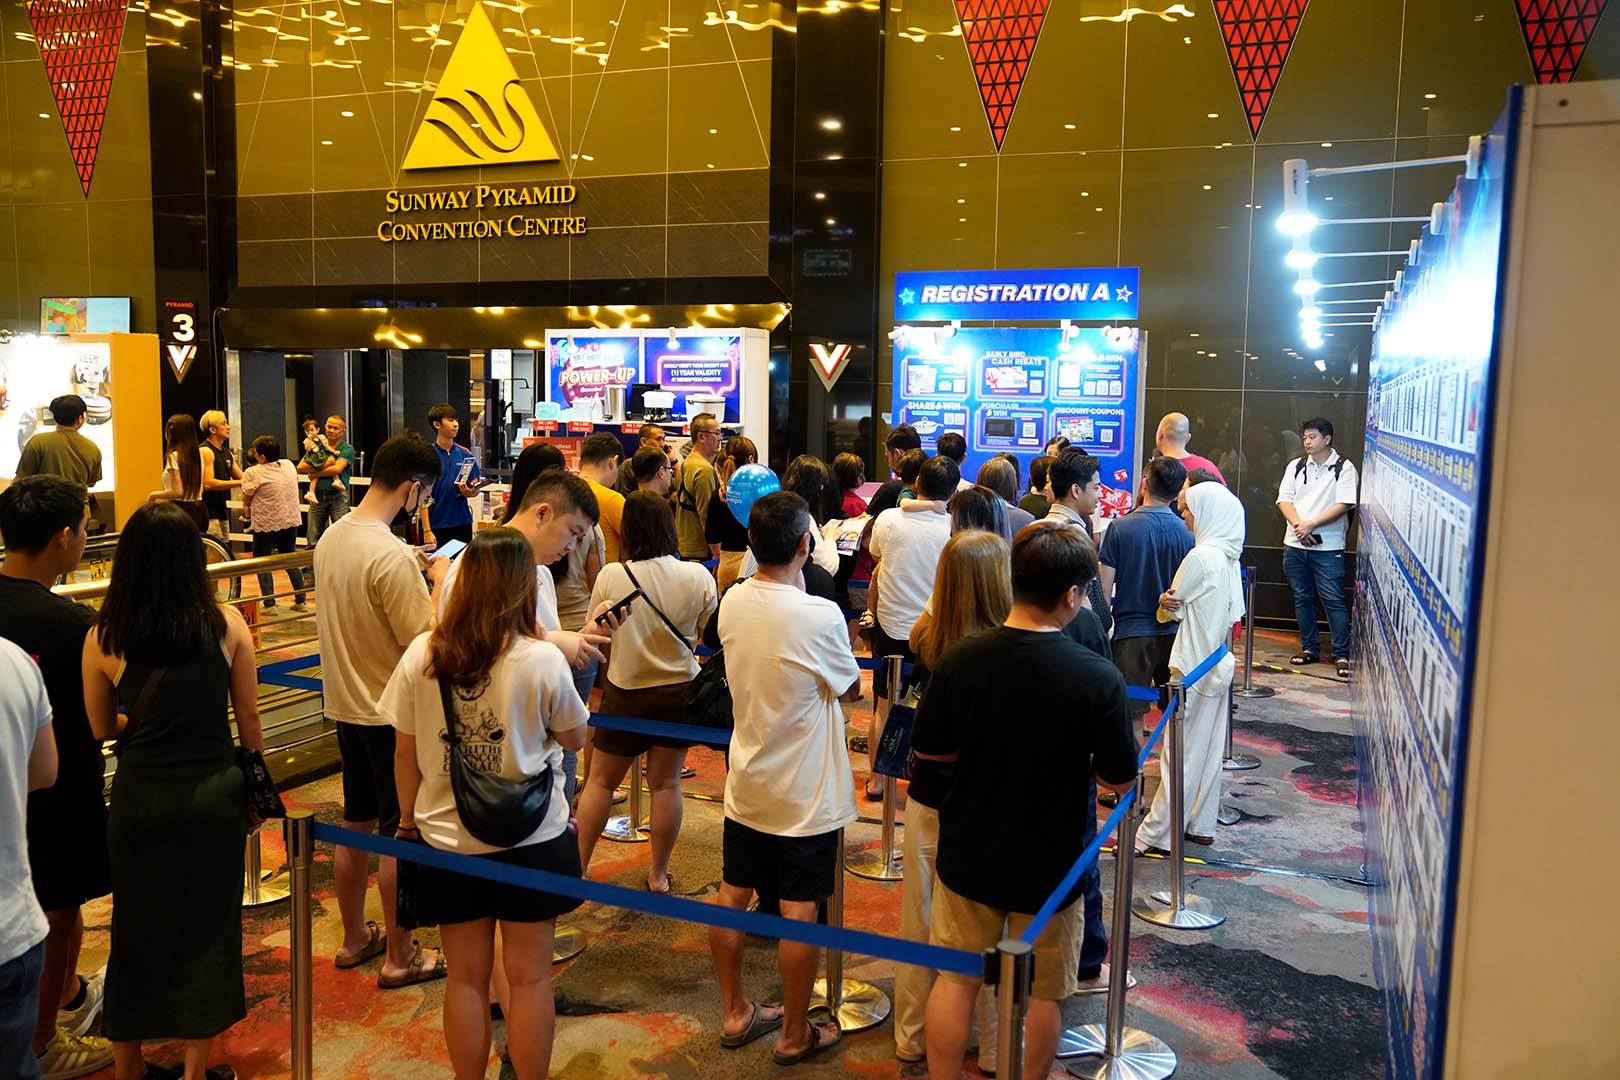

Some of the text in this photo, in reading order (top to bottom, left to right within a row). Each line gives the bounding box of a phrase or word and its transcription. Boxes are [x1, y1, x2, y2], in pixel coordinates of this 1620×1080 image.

[386, 184, 576, 213] SUNWAY PYRAMID
[377, 214, 587, 242] CONVENTION CENTRE
[921, 282, 1110, 304] REGISTRATION A
[172, 313, 195, 342] 3
[1014, 358, 1042, 366] REBATE
[559, 367, 636, 386] POWER-UP
[907, 401, 935, 410] SHARE
[943, 401, 961, 410] WIN
[992, 409, 1008, 417] WIN
